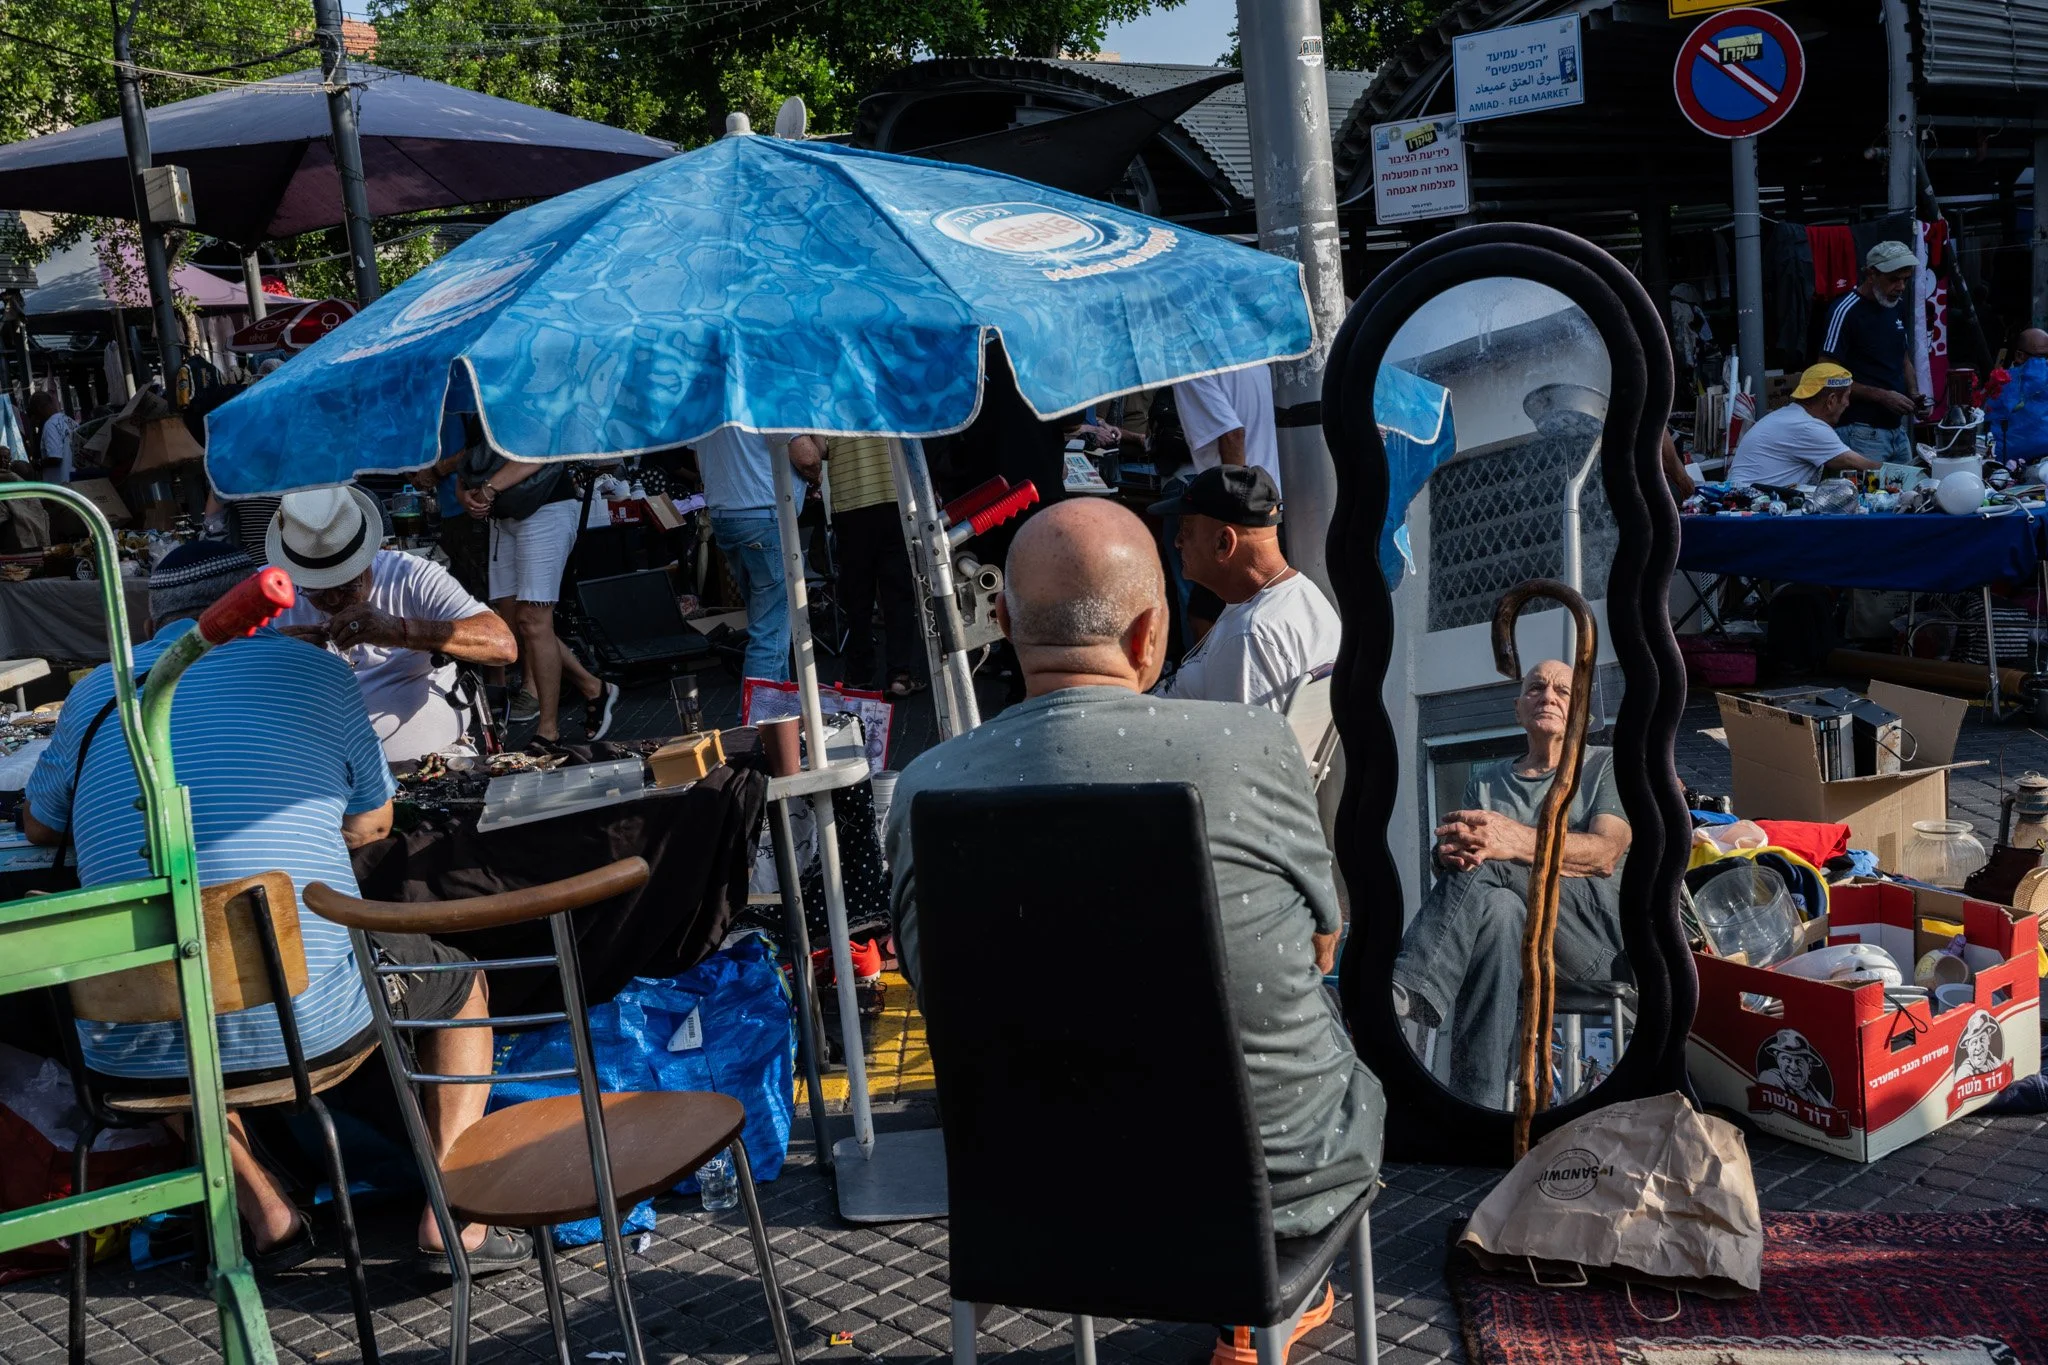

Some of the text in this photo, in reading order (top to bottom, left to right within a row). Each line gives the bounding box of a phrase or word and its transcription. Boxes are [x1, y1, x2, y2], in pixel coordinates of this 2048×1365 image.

[1486, 48, 1518, 63] עמיעד
[1527, 43, 1547, 55] יריד
[1468, 100, 1499, 113] AMIAD
[1508, 96, 1529, 106] FLEA
[1531, 88, 1570, 102] MARKET
[1388, 147, 1450, 165] לידיעת הציבור
[1381, 163, 1459, 181] באתר זה מופעלות
[1386, 180, 1456, 196] מצלמות אבטחה
[1868, 1044, 1949, 1089] משדות הנגב המערבי
